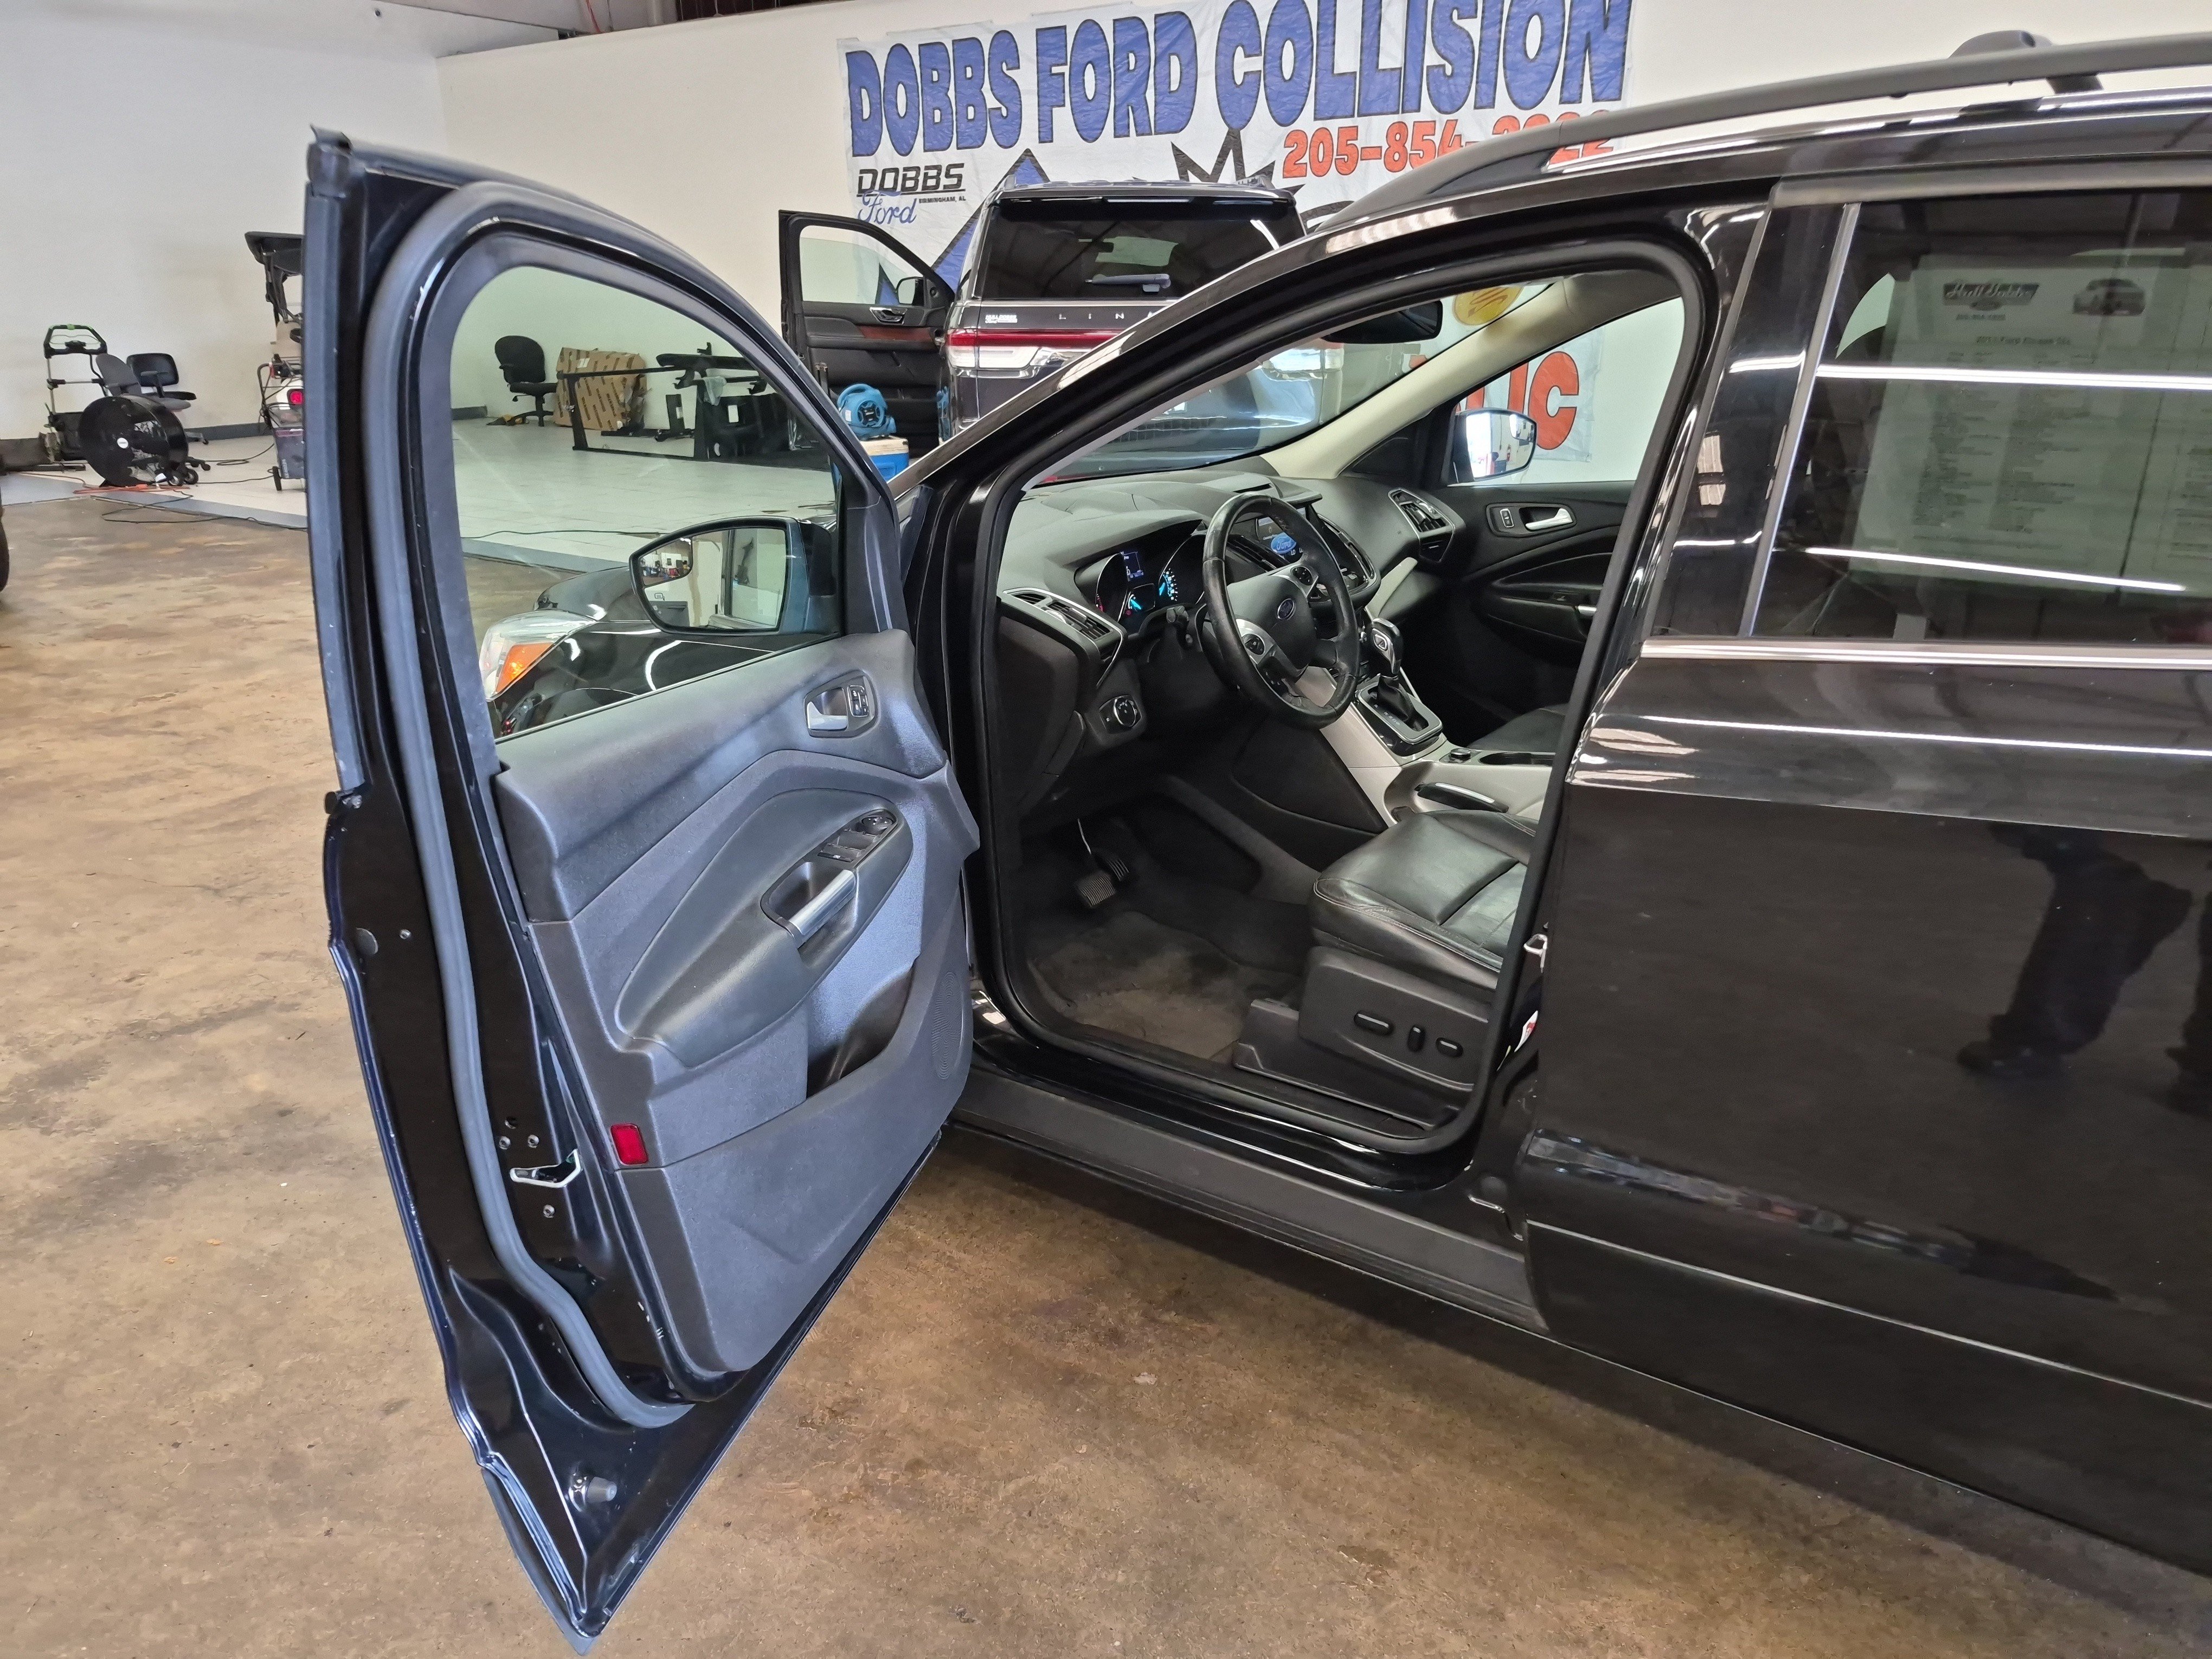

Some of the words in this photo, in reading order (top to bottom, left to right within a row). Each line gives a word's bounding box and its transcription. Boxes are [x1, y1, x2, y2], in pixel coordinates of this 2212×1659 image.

[846, 30, 1022, 157] DOBBS
[1036, 11, 1198, 144] FORD
[1216, 0, 1629, 129] COLLISION
[858, 163, 964, 194] DOBBS
[857, 190, 917, 225] Ford
